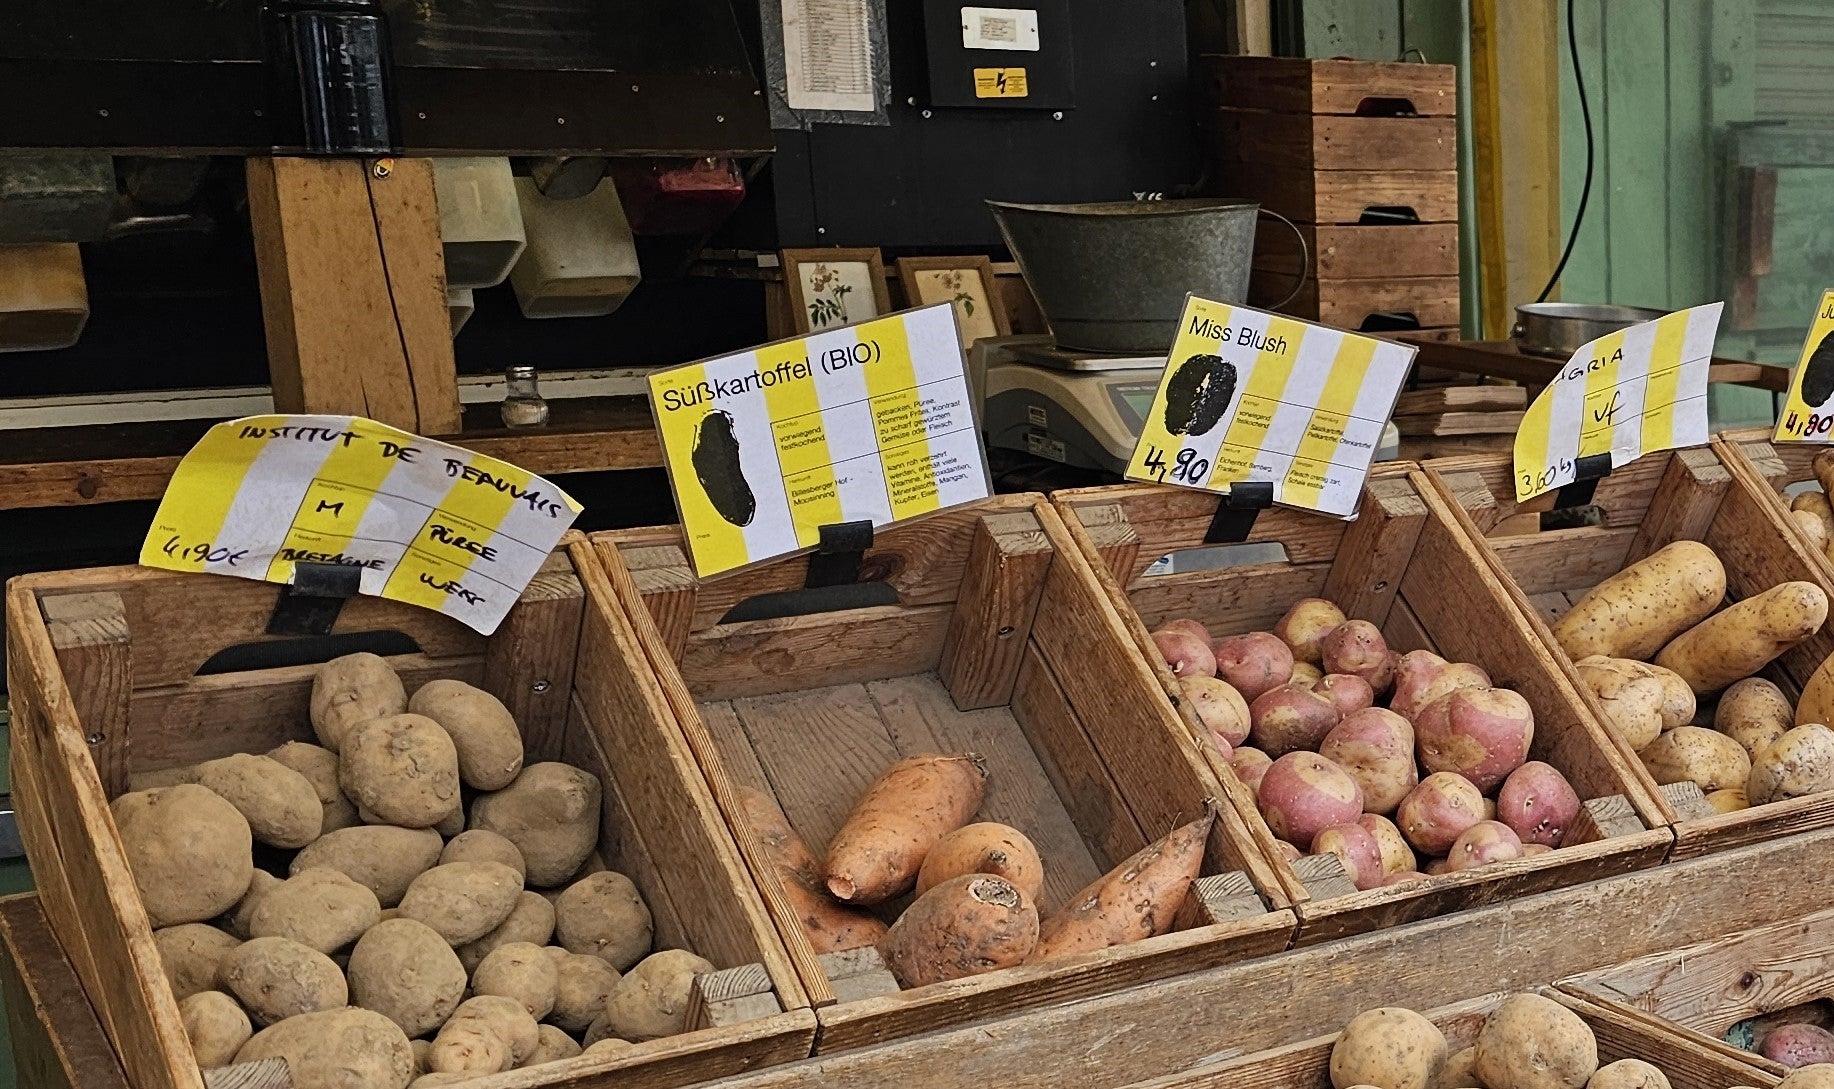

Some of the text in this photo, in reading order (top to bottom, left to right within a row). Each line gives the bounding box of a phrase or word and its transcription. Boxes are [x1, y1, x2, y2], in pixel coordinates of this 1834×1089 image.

[1188, 315, 1289, 356] Miss Blush
[662, 339, 882, 412] Süßkartoffel (BIO)
[877, 413, 908, 425] Pommes
[931, 400, 961, 411] Kontrast
[778, 426, 822, 442] vorwiegend
[879, 427, 889, 435] zu
[889, 421, 912, 431] scharf
[911, 427, 927, 435] oder
[927, 419, 953, 430] Fleisch
[780, 434, 826, 451] festkochend
[886, 462, 905, 471] kann
[919, 451, 947, 462] verzehrt
[888, 468, 917, 480] werden,
[941, 457, 957, 465] viele
[238, 425, 563, 519] INSTITUT DE BEAUVAIS
[920, 488, 939, 497] Eisen
[315, 499, 345, 519] M
[430, 524, 498, 562] PÜREE
[280, 547, 386, 571] BRETAGNE
